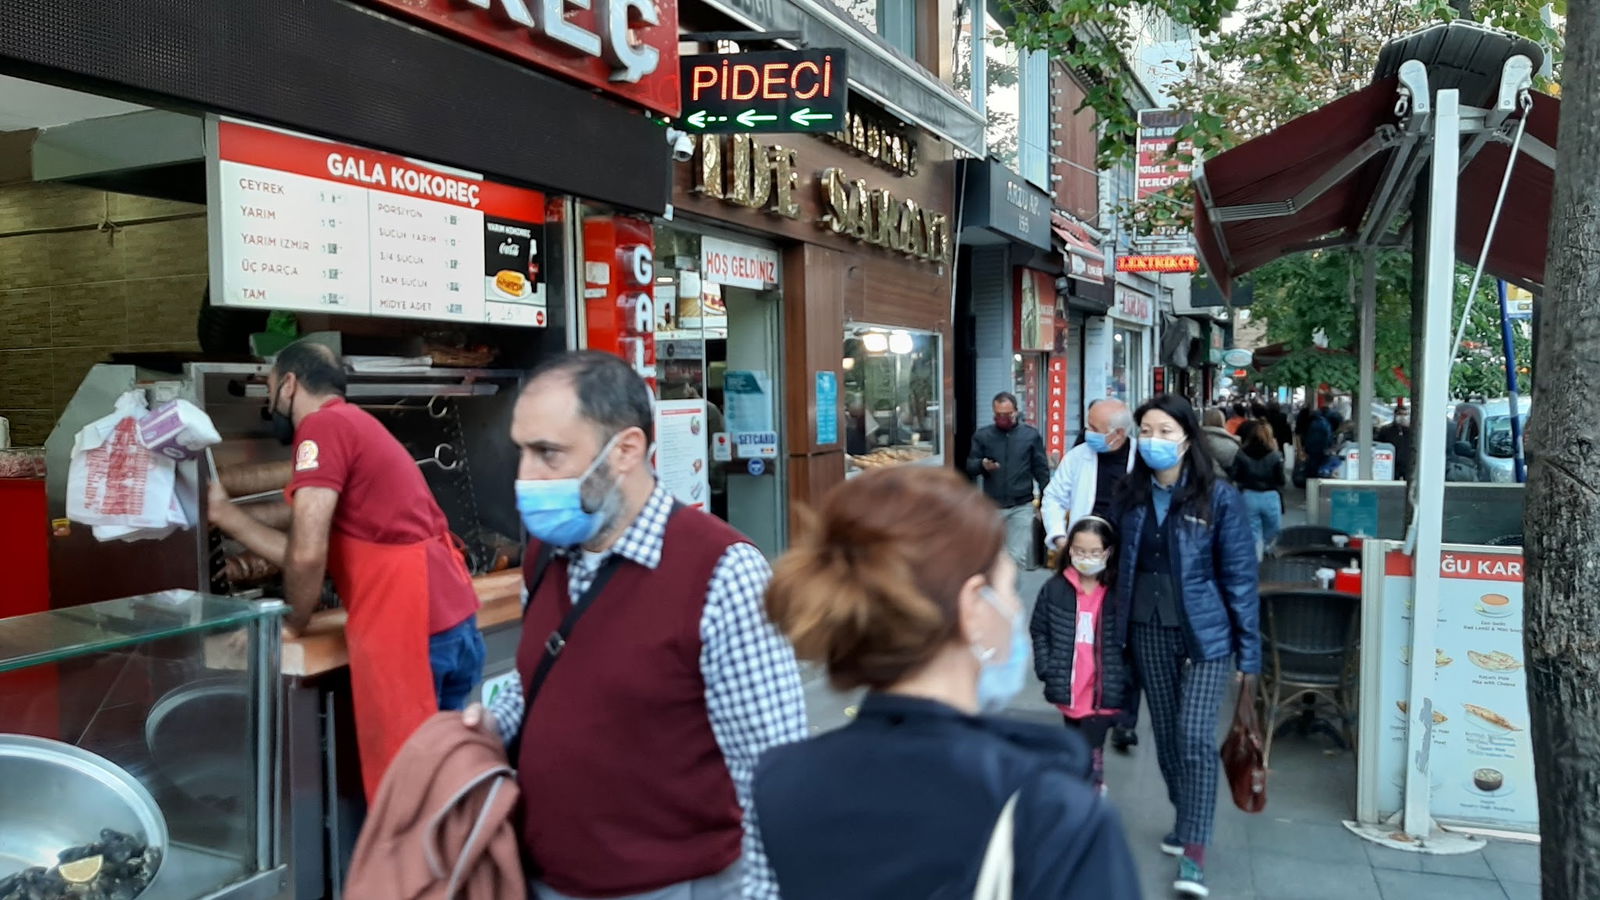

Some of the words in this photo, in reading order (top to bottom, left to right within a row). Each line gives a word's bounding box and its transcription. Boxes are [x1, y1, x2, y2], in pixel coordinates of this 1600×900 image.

[239, 178, 284, 195] ÇEYREK
[327, 153, 386, 186] GALA
[391, 166, 480, 208] KOKOREÇ
[240, 205, 275, 219] YARIM
[241, 233, 276, 245] YARIM
[242, 258, 257, 273] ÜÇ
[262, 262, 298, 276] PARÇA
[706, 251, 728, 281] HOŞ
[732, 253, 776, 282] GELDİNİZ
[242, 288, 266, 300] TAM
[1441, 555, 1470, 573] ĞU
[1477, 560, 1521, 576] KAR
